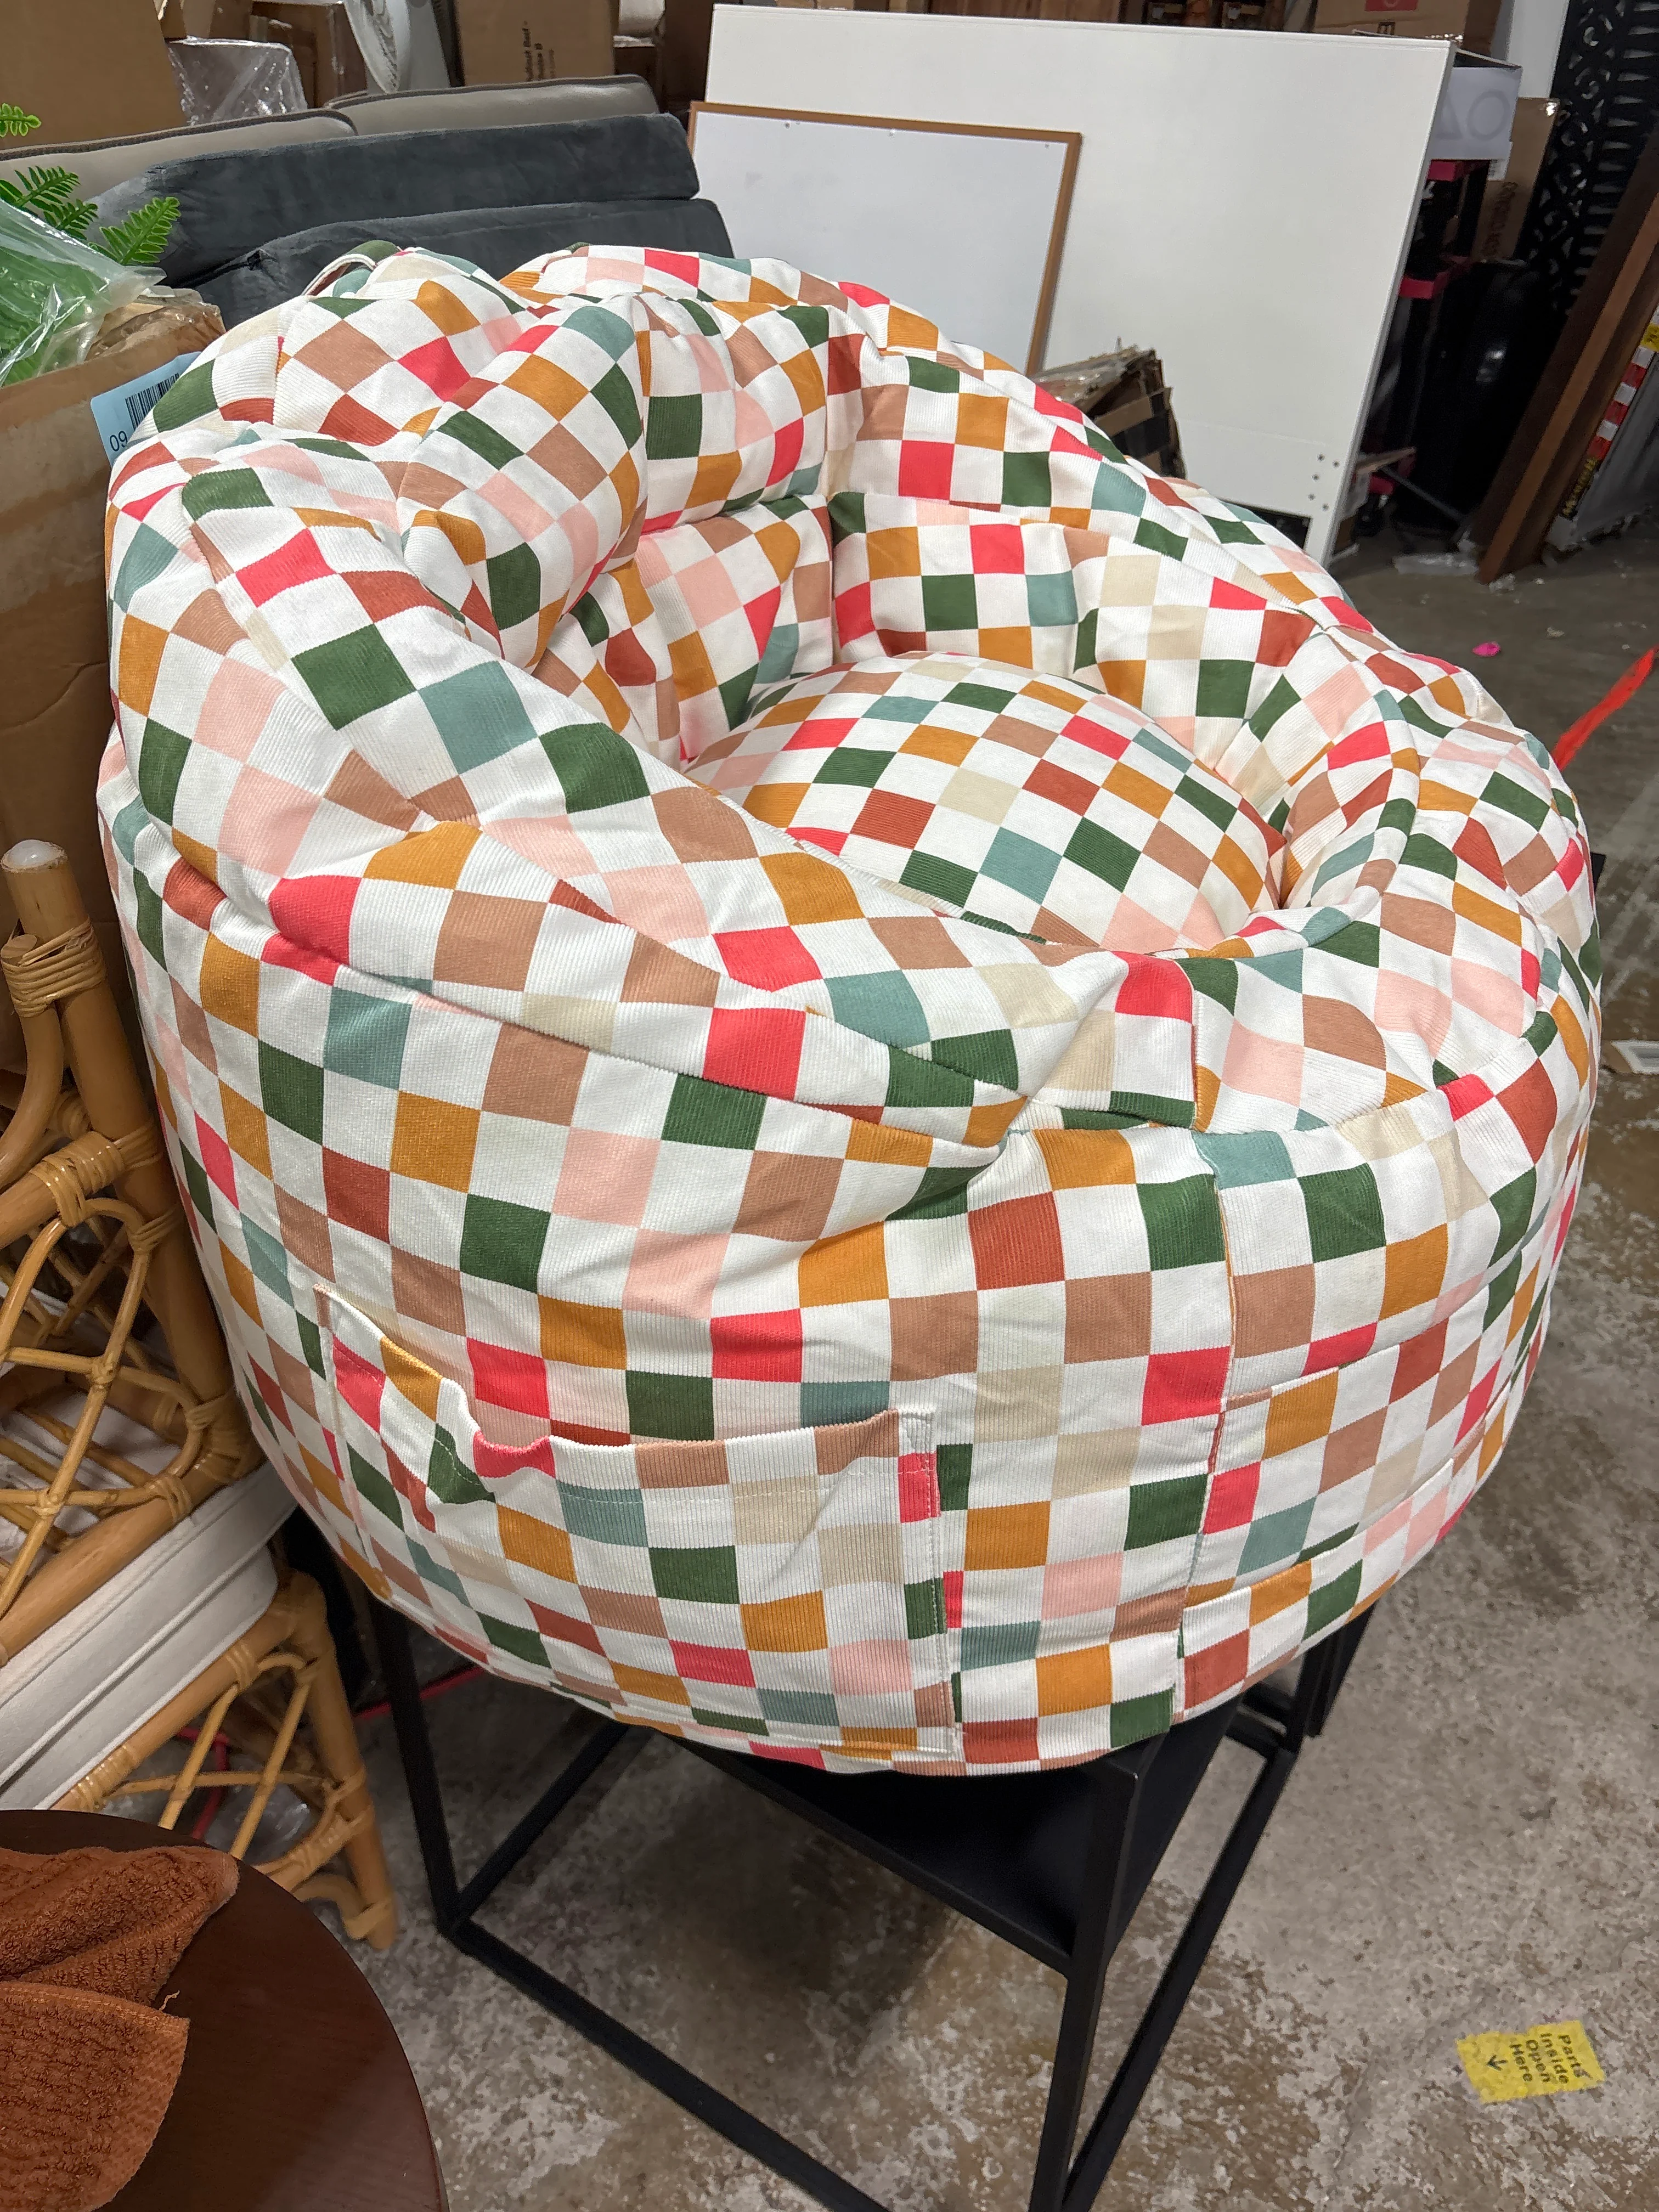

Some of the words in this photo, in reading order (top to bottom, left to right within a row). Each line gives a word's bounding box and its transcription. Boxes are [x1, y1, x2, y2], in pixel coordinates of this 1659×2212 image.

[1510, 2044, 1533, 2082] Here
[1526, 2039, 1551, 2083] Open
[1540, 2033, 1568, 2083] Inside
